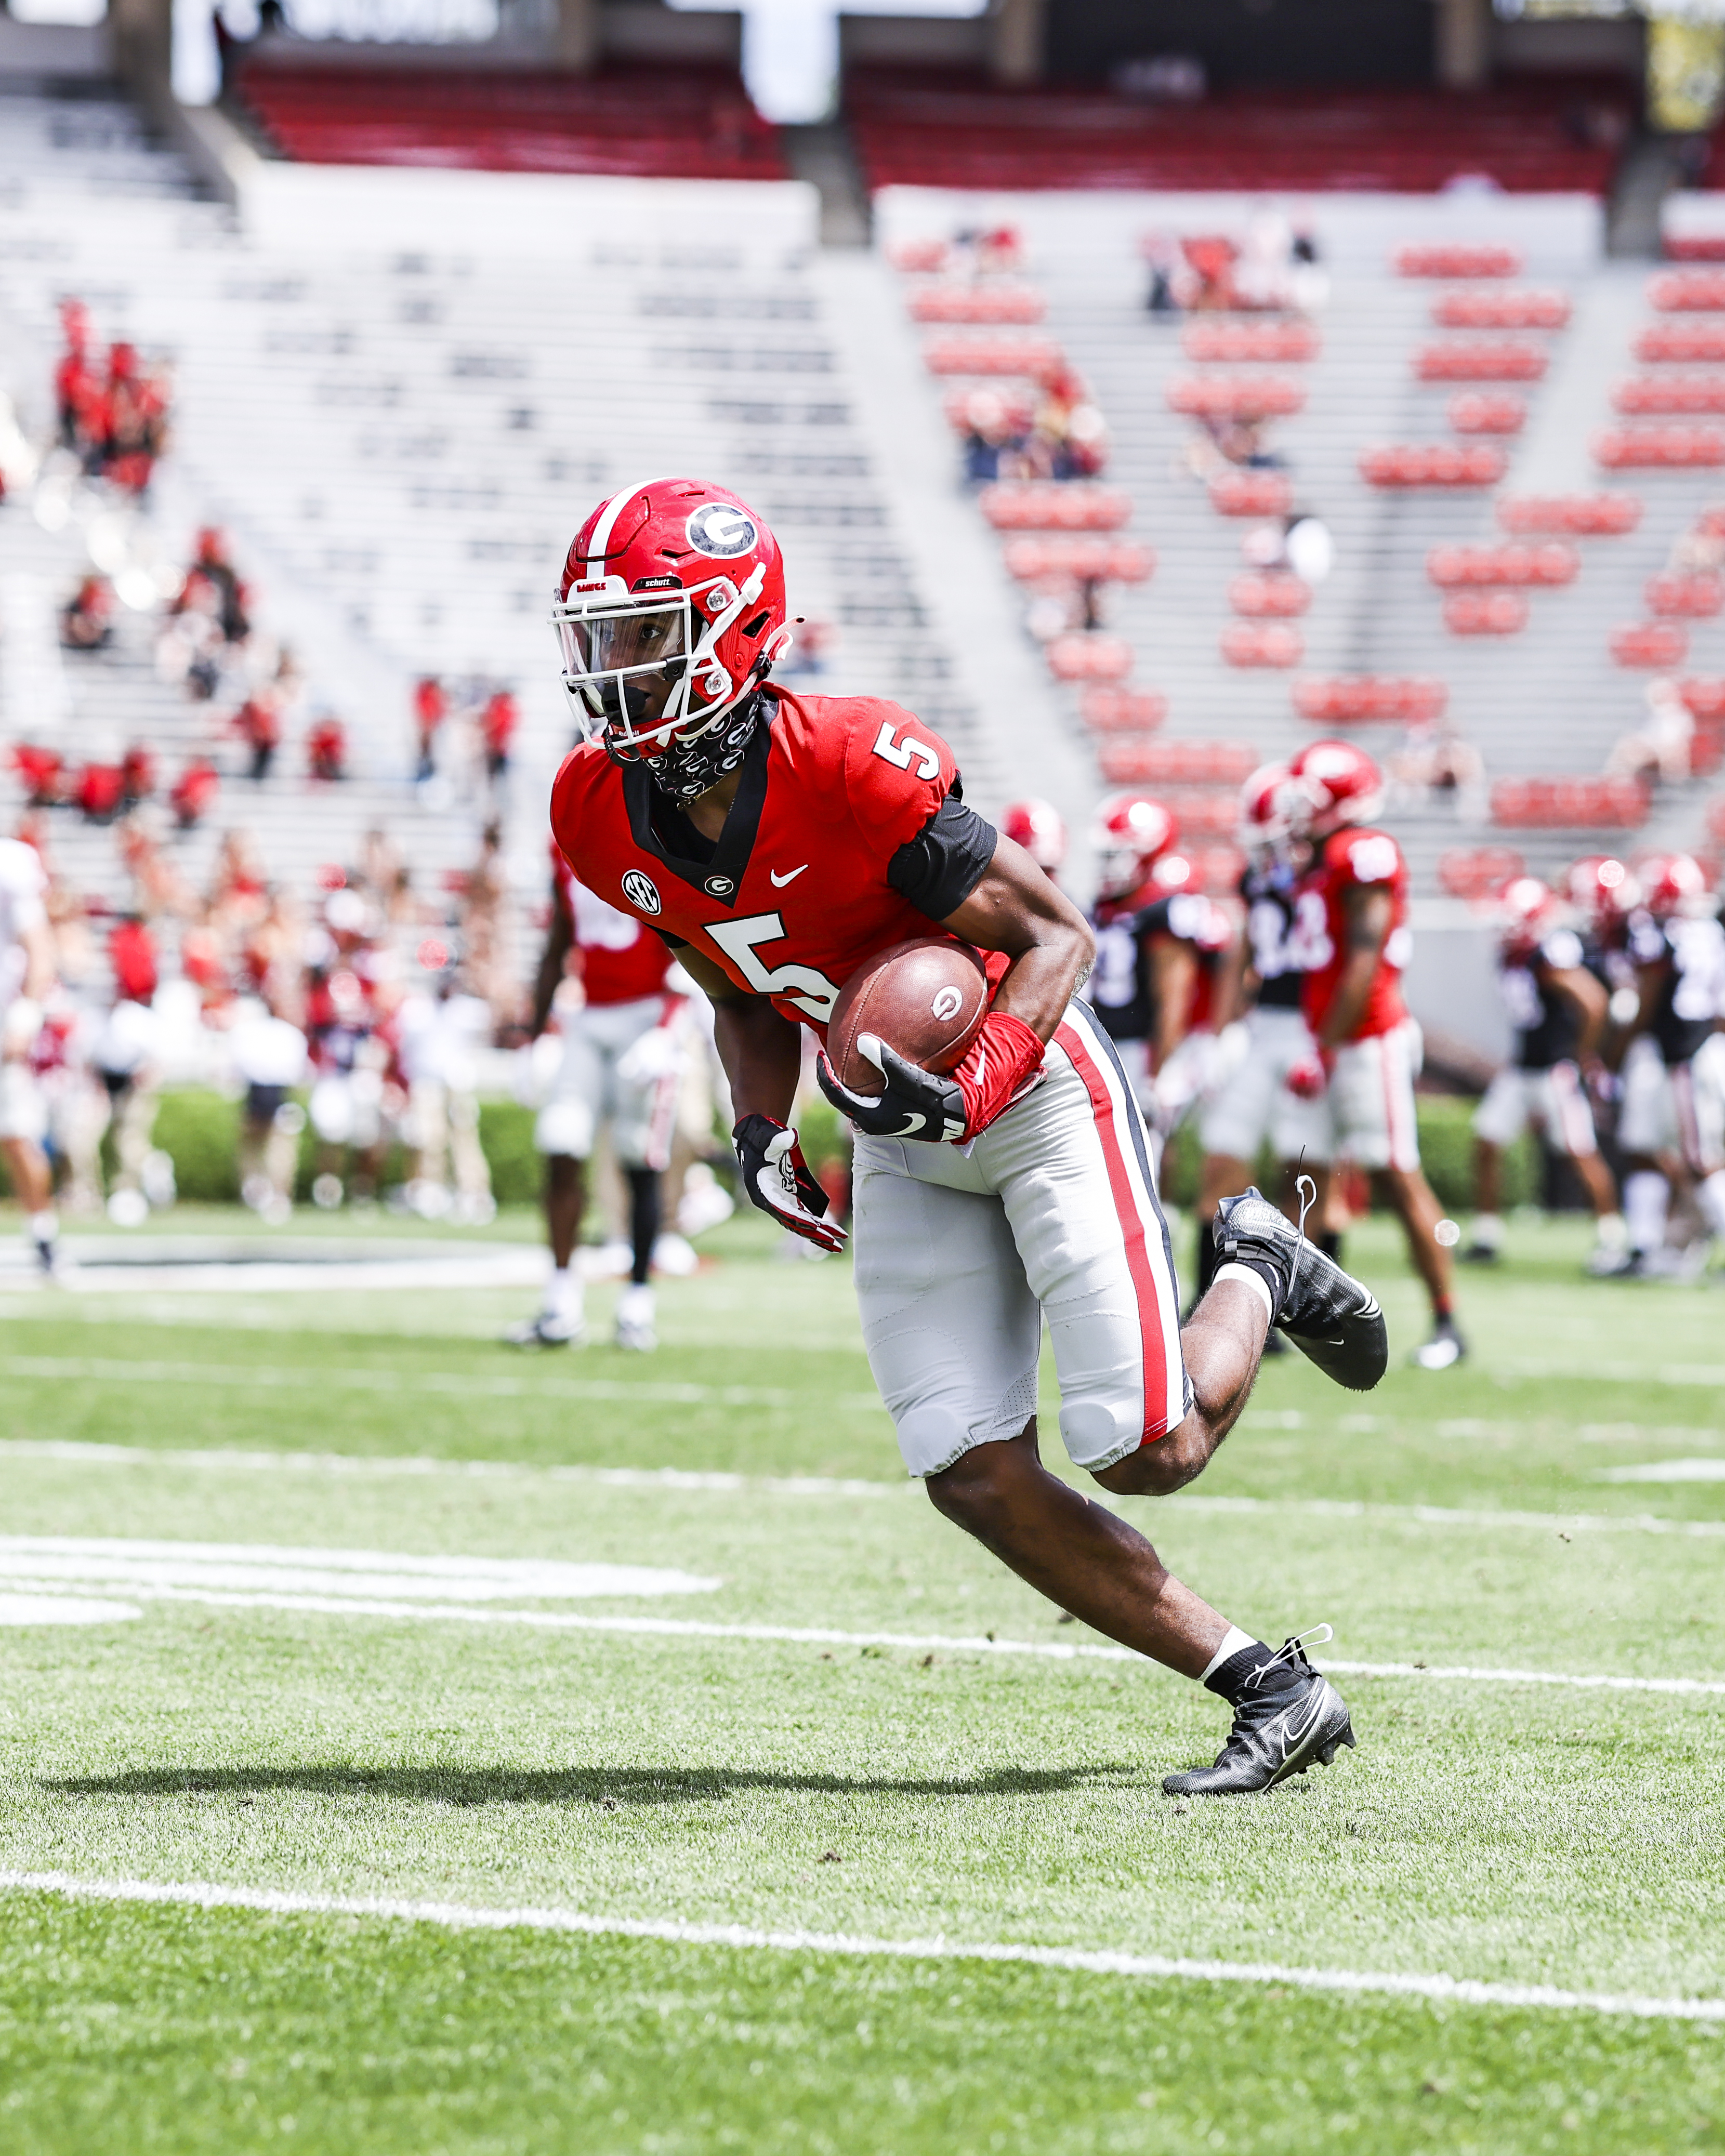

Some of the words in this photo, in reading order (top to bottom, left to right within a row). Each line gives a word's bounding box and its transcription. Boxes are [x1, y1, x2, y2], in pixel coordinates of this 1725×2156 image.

[576, 582, 607, 593] DAWGS
[872, 721, 940, 781] 5
[625, 874, 658, 912] SEC
[703, 912, 841, 1023] 5
[932, 985, 963, 1021] G
